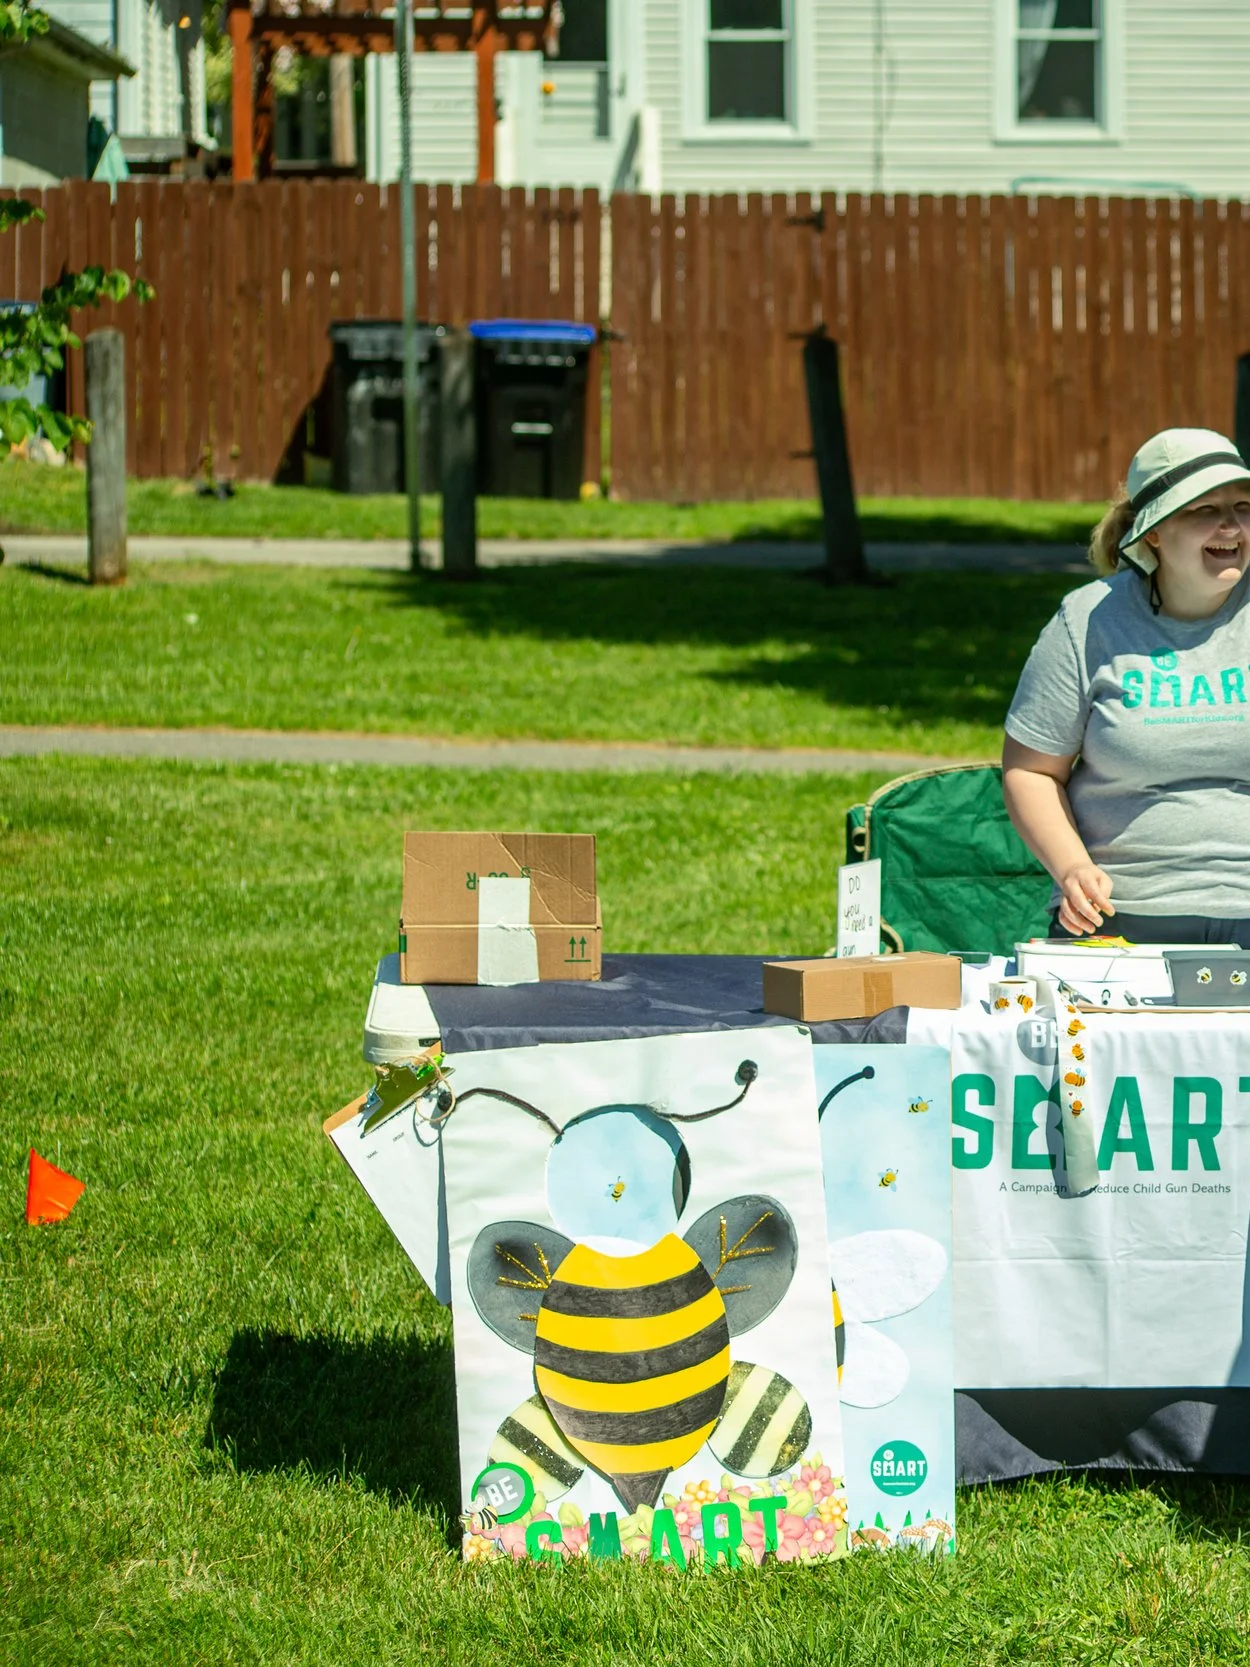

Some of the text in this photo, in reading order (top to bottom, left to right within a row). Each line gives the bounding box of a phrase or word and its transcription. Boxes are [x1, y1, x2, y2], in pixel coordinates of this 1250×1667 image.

[1156, 655, 1172, 667] BE
[999, 1182, 1007, 1192] A
[1011, 1181, 1068, 1195] Campaign
[1133, 1183, 1161, 1194] Child
[1165, 1183, 1188, 1194] Gun
[1191, 1183, 1231, 1194] Deaths
[873, 1460, 926, 1477] SMART
[485, 1475, 519, 1508] BE
[525, 1495, 788, 1574] SMART
